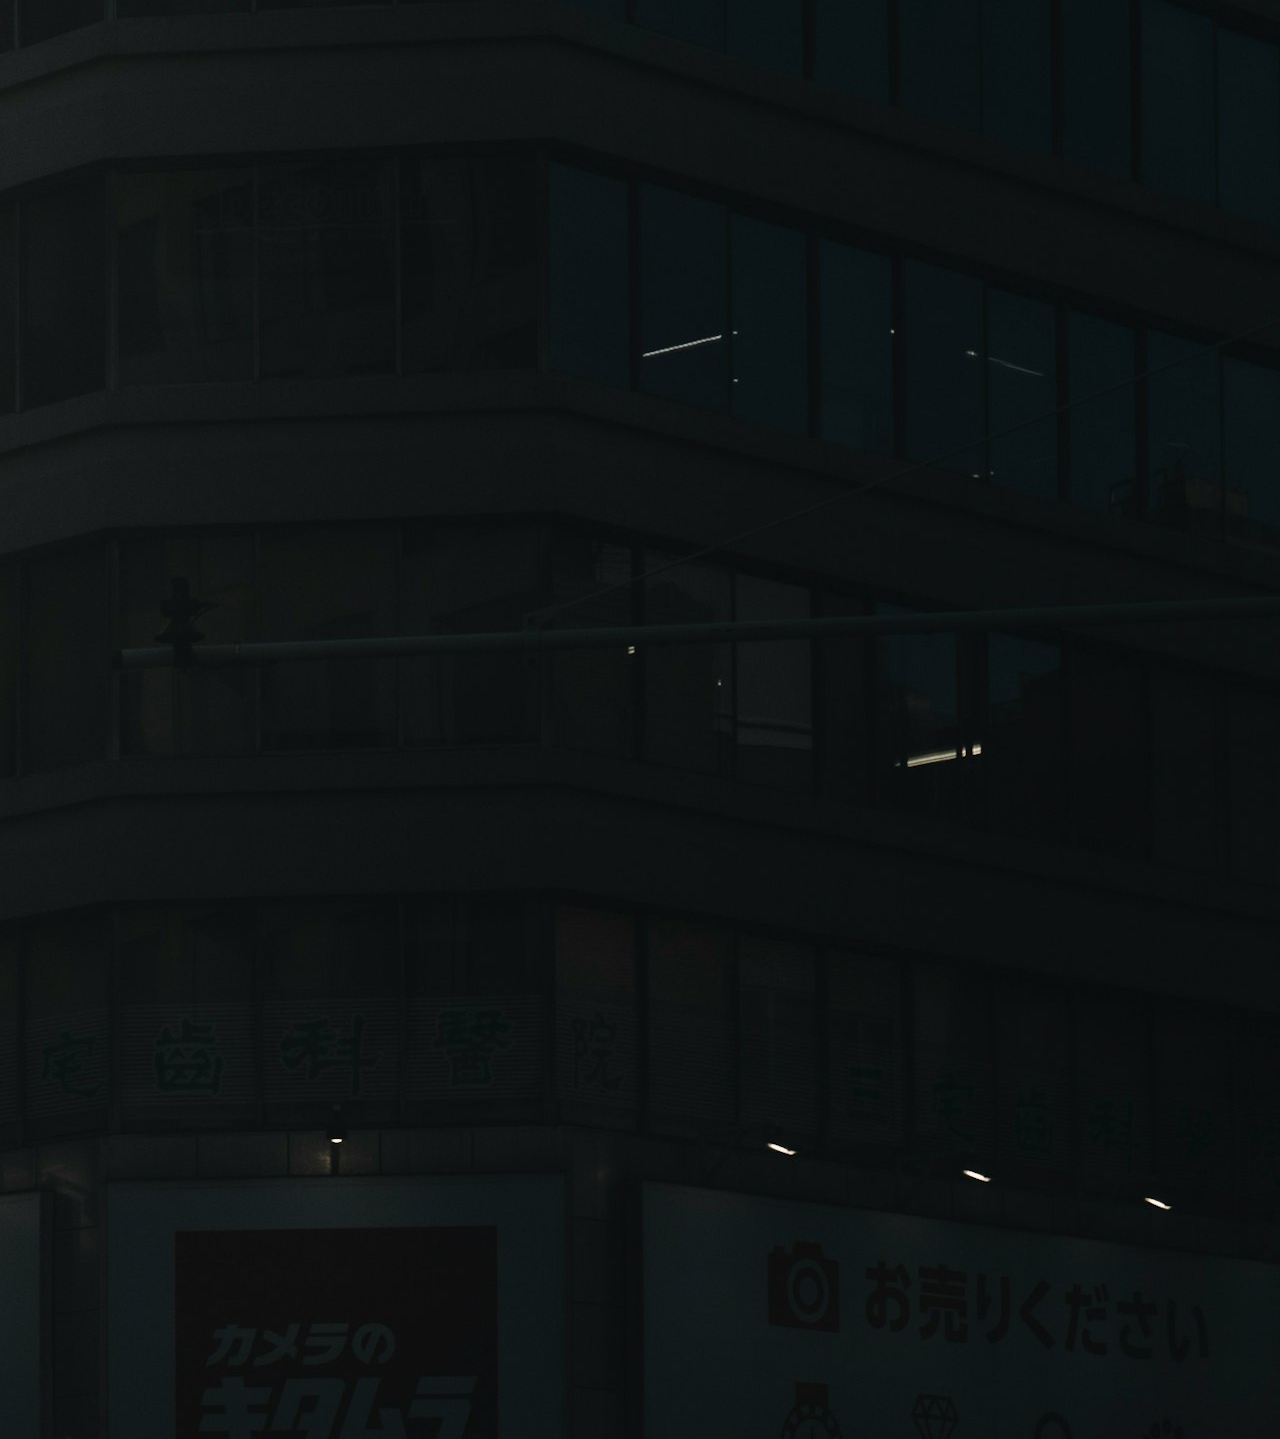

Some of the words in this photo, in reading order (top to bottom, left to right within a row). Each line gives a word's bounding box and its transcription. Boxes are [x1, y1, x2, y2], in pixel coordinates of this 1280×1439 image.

[204, 1322, 397, 1367] カメラの
[863, 1260, 1210, 1363] お売りください
